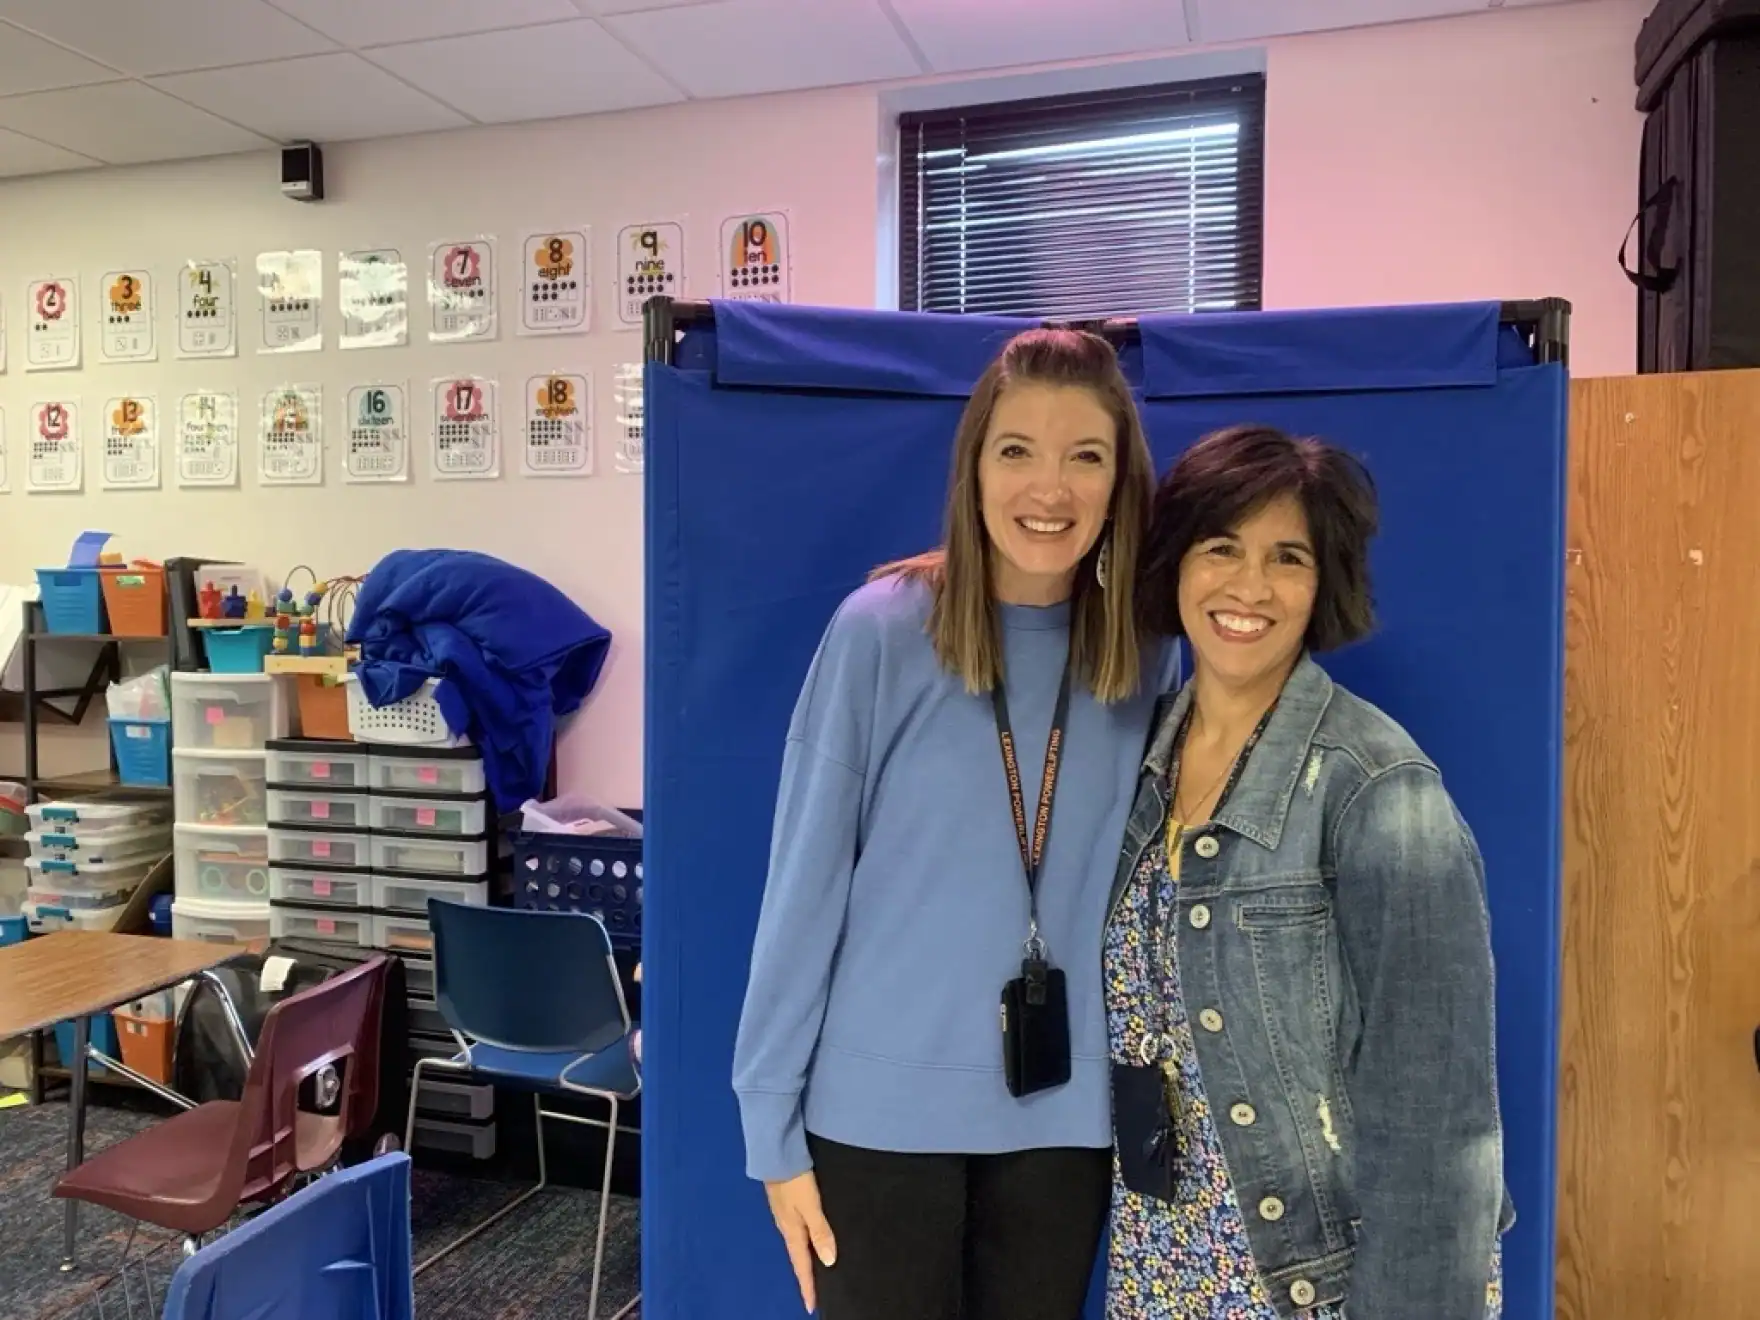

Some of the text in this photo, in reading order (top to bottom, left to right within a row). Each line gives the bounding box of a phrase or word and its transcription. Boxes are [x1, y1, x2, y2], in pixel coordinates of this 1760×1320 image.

[641, 231, 658, 256] 9
[742, 220, 767, 247] 10
[457, 250, 469, 274] 7
[549, 238, 563, 263] 8
[743, 249, 768, 264] ten
[537, 262, 572, 281] eight
[635, 256, 665, 271] nine
[121, 274, 133, 300] 3
[199, 270, 212, 294] 4
[45, 284, 56, 307] 2
[192, 294, 220, 308] four
[367, 389, 386, 414] 16
[456, 386, 473, 410] 17
[547, 379, 568, 405] 18
[47, 403, 61, 427] 12
[123, 400, 137, 423] 13
[1001, 731, 1020, 790] LEXINGTON
[1033, 728, 1061, 866] LEXINGTON POWERLIFTING
